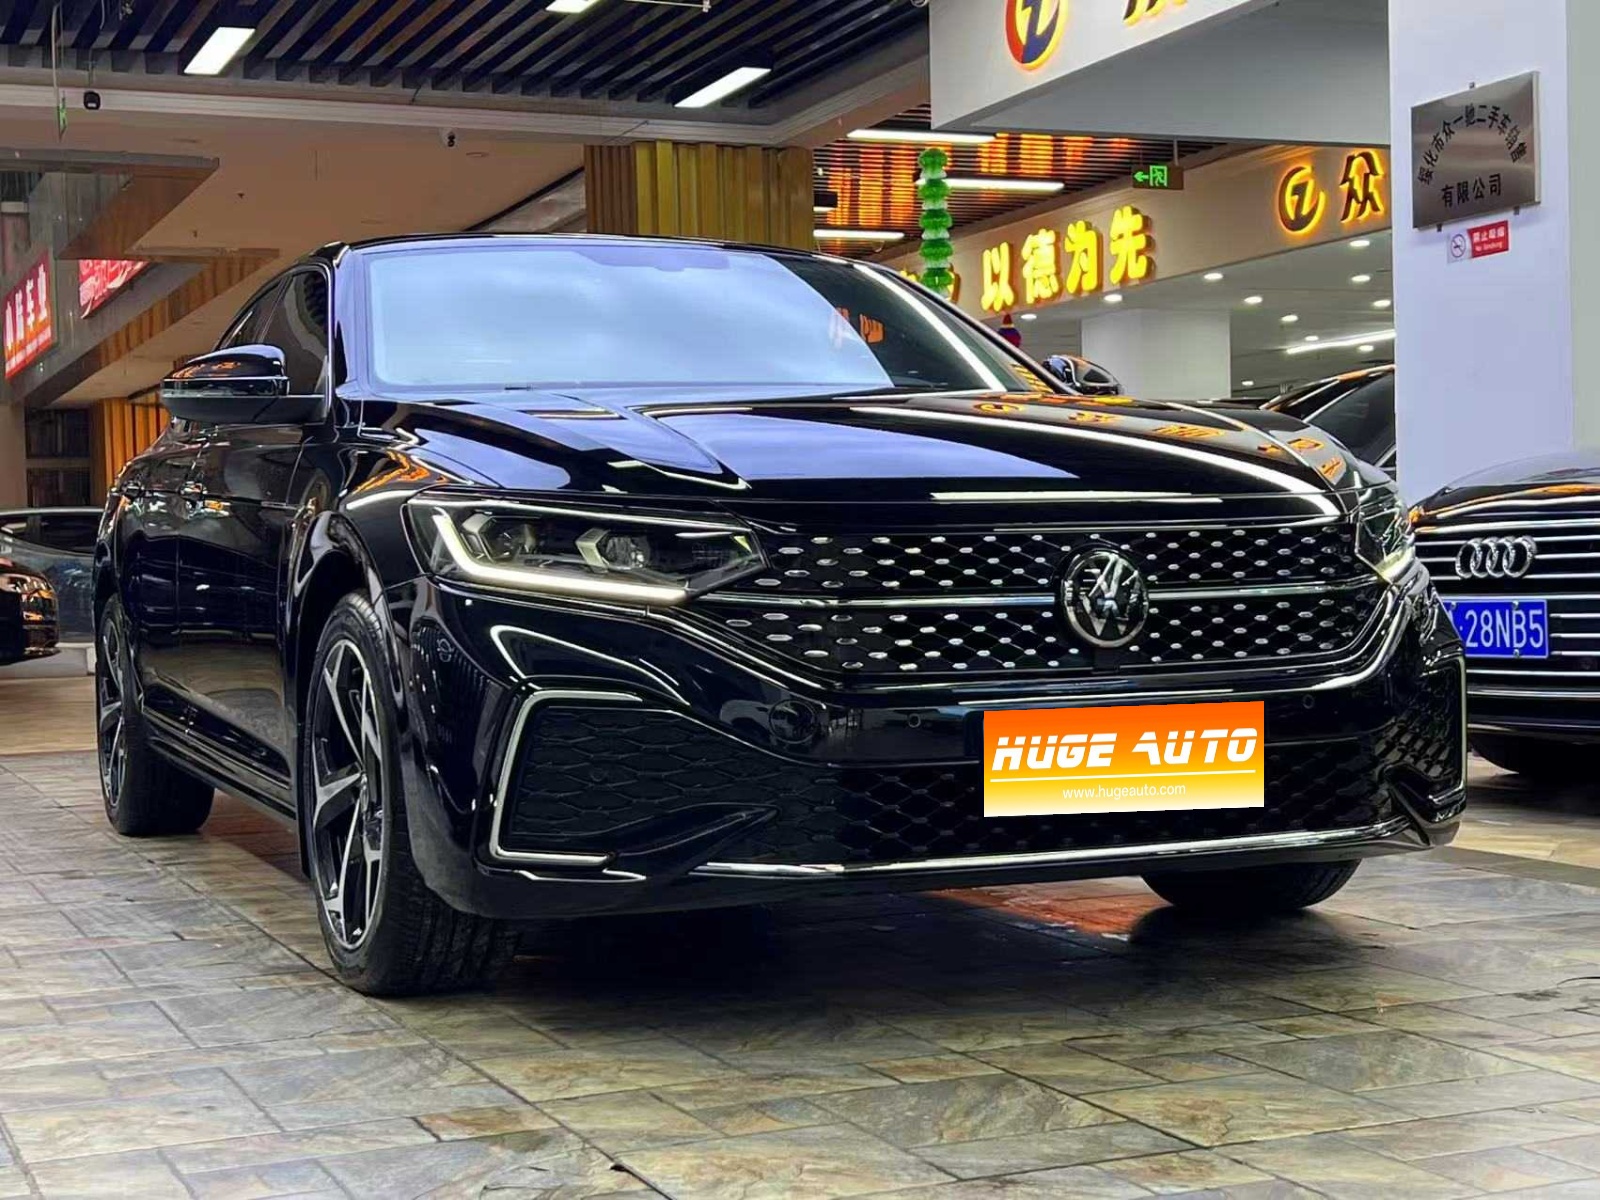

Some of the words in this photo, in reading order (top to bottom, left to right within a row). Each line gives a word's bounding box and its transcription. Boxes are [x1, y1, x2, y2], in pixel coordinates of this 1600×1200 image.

[1340, 149, 1385, 222] 众
[1441, 172, 1502, 208] 有限公司
[981, 205, 1149, 312] 以德为先
